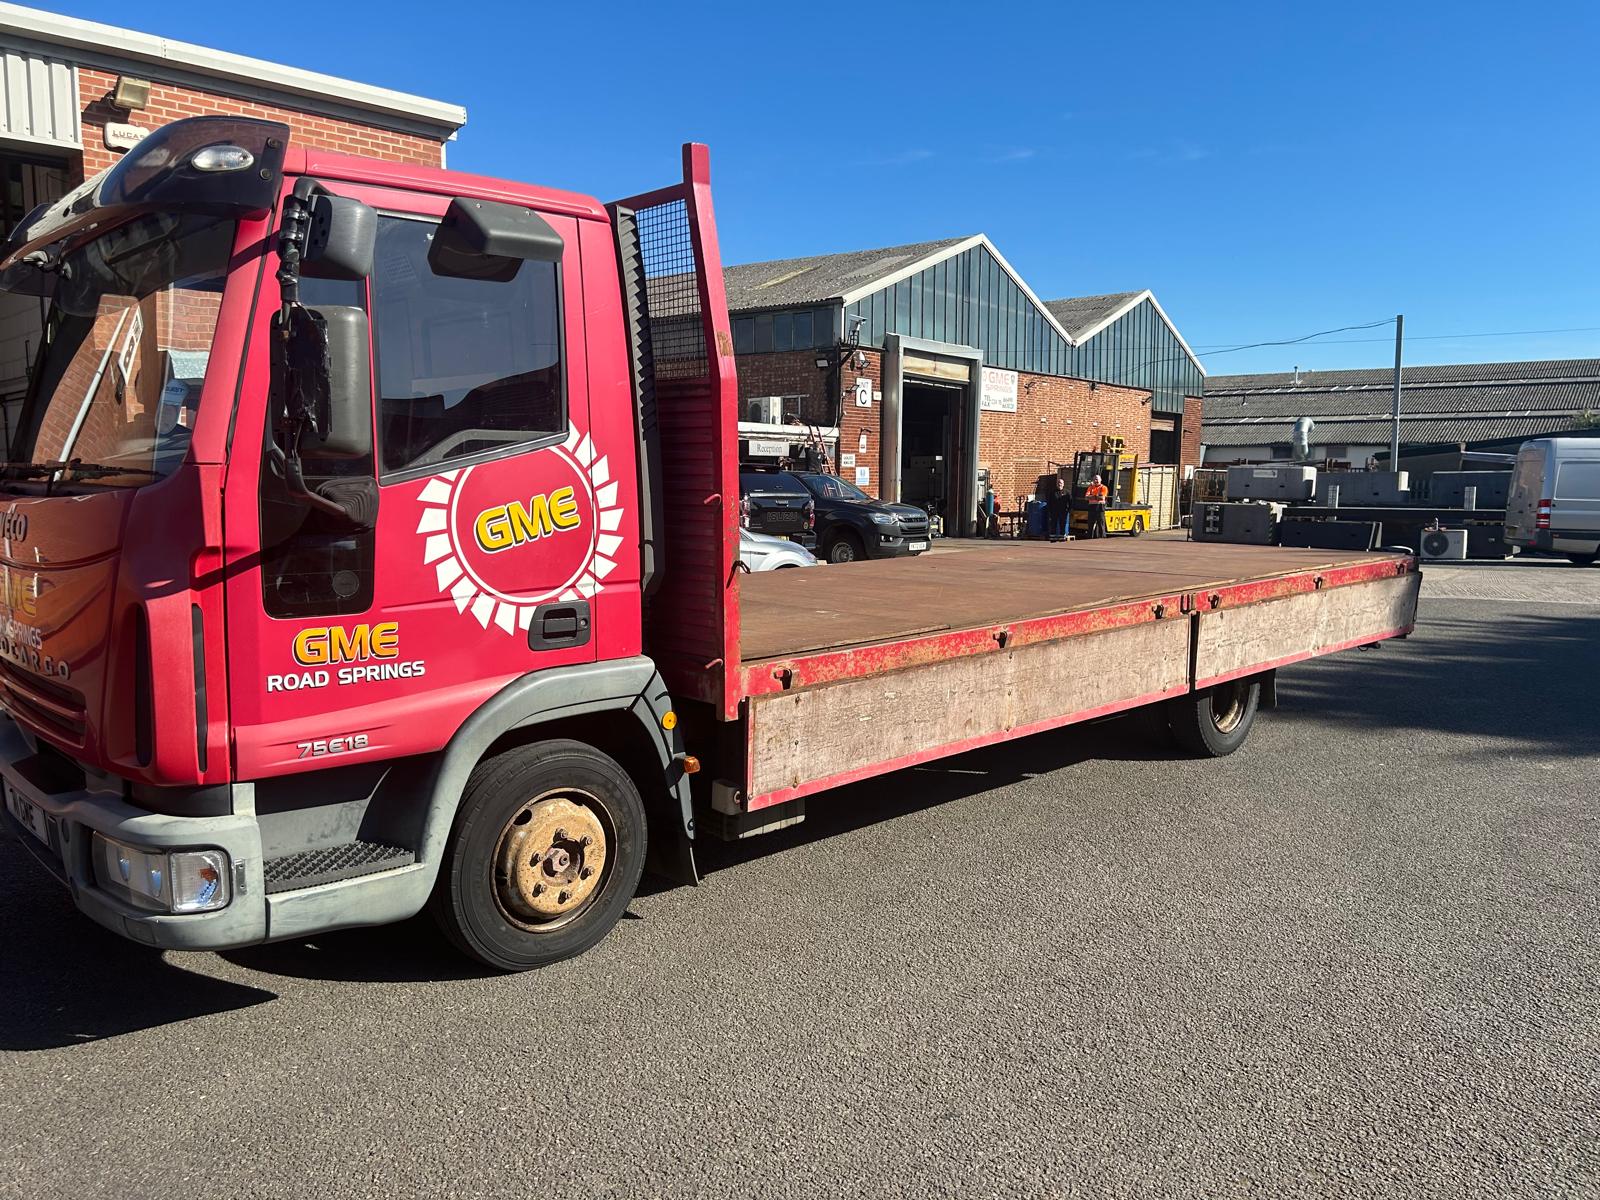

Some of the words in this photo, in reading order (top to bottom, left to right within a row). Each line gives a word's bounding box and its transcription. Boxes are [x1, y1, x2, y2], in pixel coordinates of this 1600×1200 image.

[988, 371, 1010, 385] GME
[860, 389, 868, 405] C
[0, 511, 28, 542] VECO
[475, 485, 580, 553] GME
[766, 511, 798, 522] ISUZU
[293, 621, 399, 667] GME
[267, 670, 330, 693] ROAD
[338, 660, 426, 686] SPRINGS
[297, 734, 369, 759] 75E18
